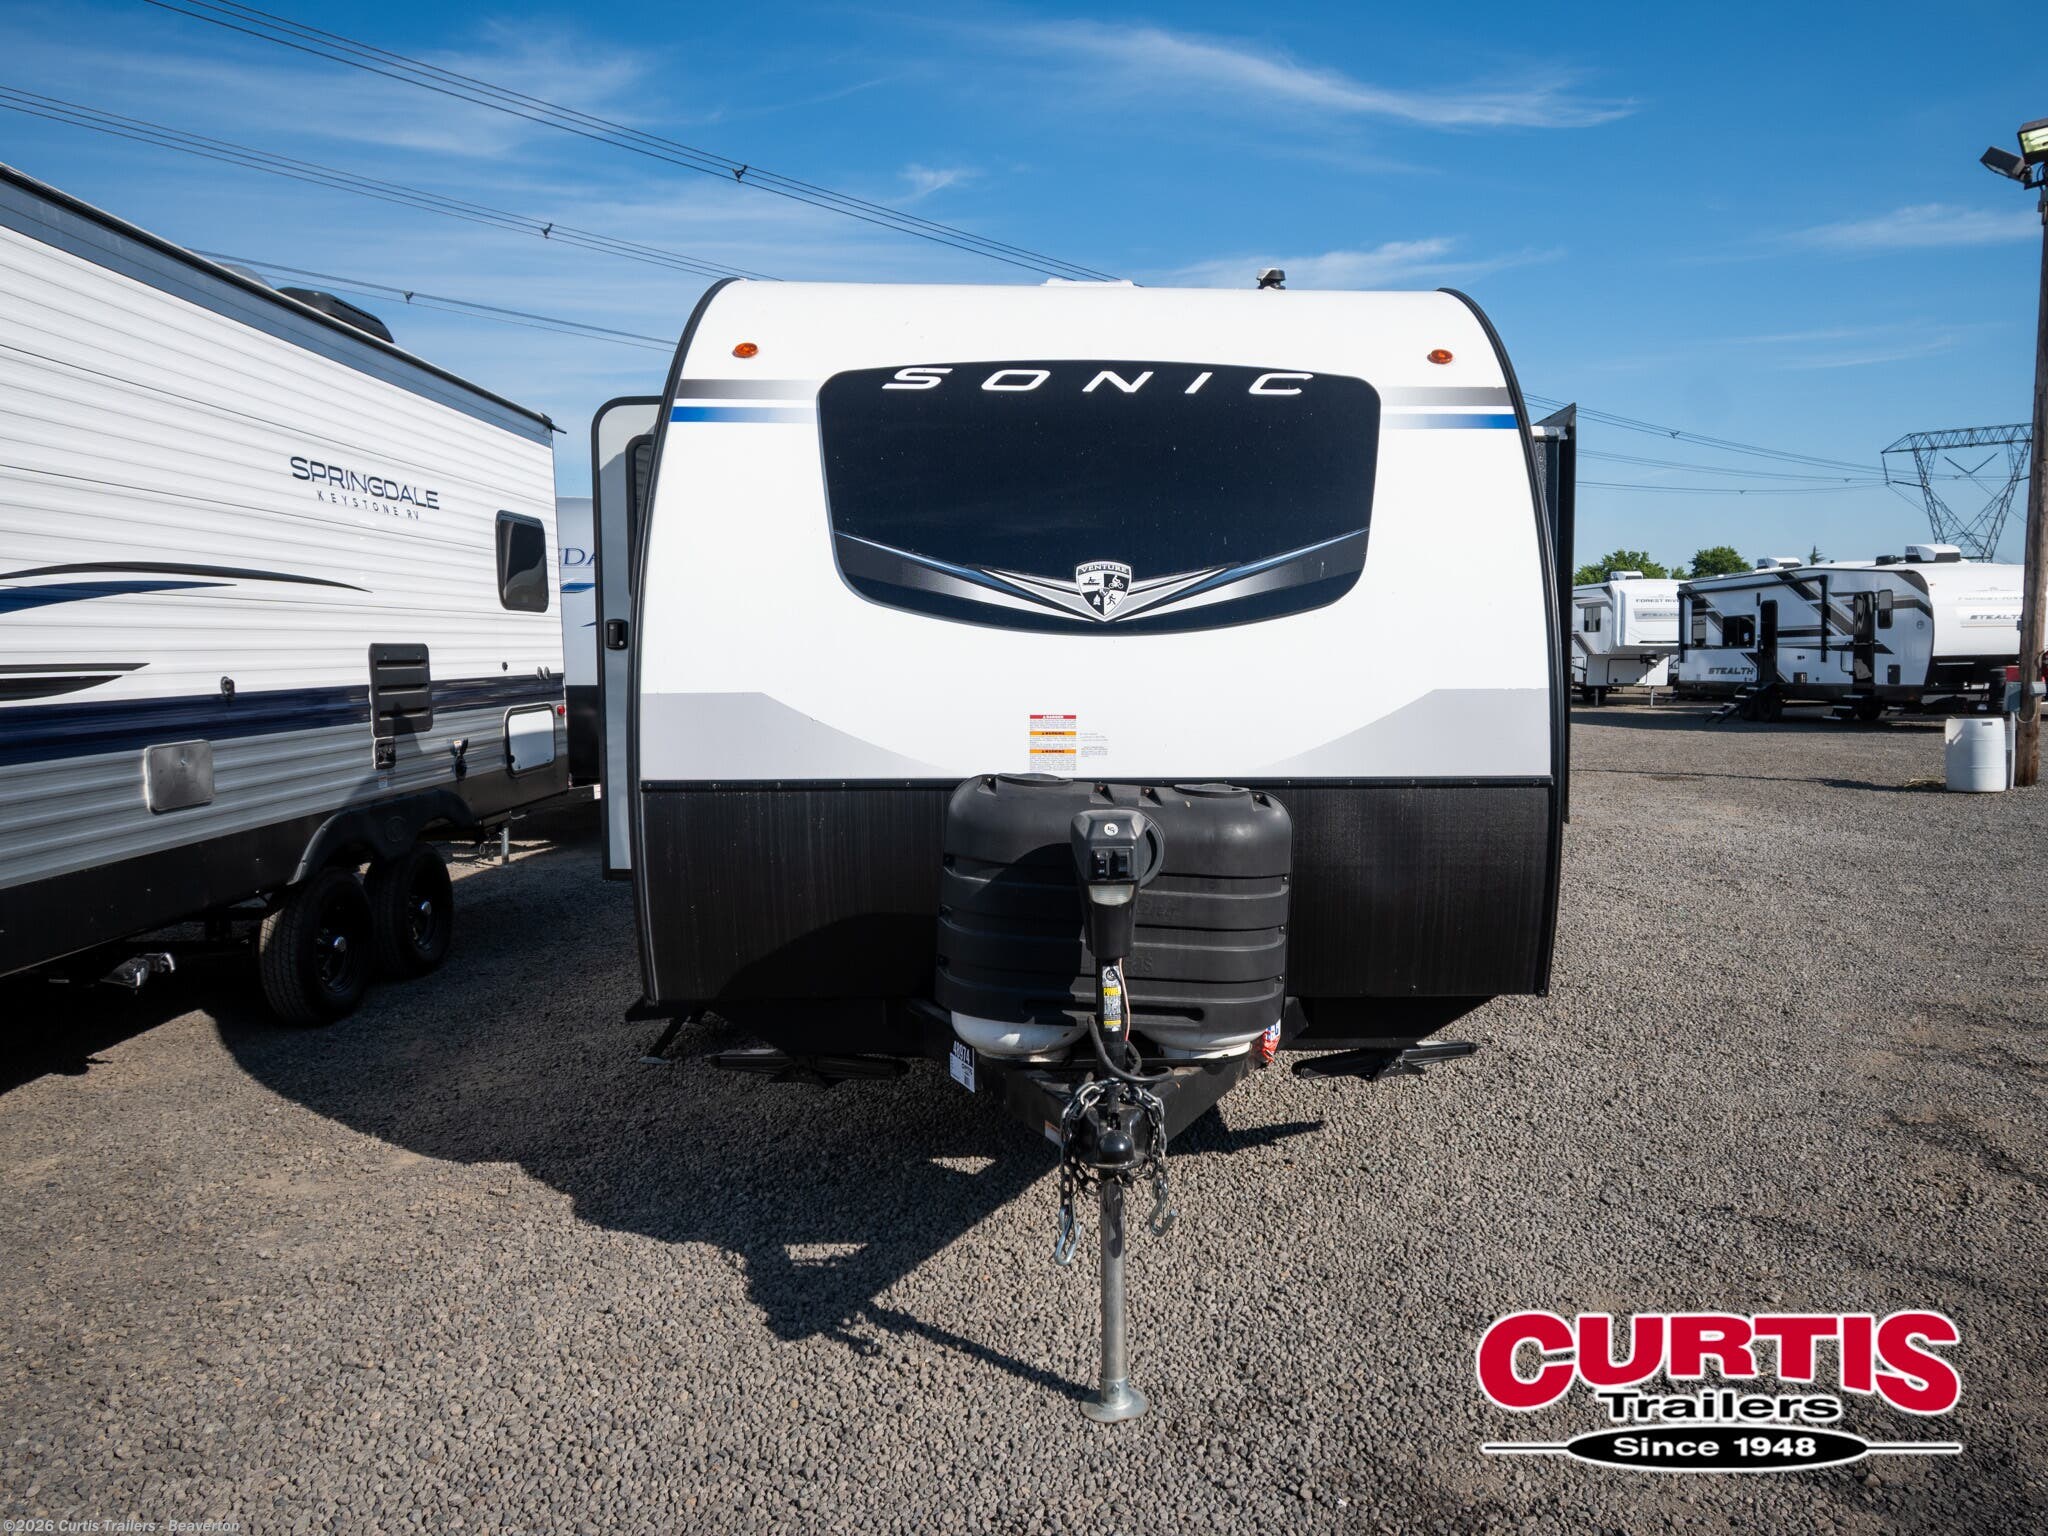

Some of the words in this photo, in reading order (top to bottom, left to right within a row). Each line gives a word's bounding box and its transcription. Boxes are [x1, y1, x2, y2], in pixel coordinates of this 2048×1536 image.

[881, 367, 1315, 397] SONIC
[290, 456, 440, 511] SPRINGDALE
[316, 489, 399, 517] KEYSTONE
[406, 509, 420, 521] RV
[1080, 564, 1128, 573] VENTURE
[1708, 667, 1754, 675] STEALTH
